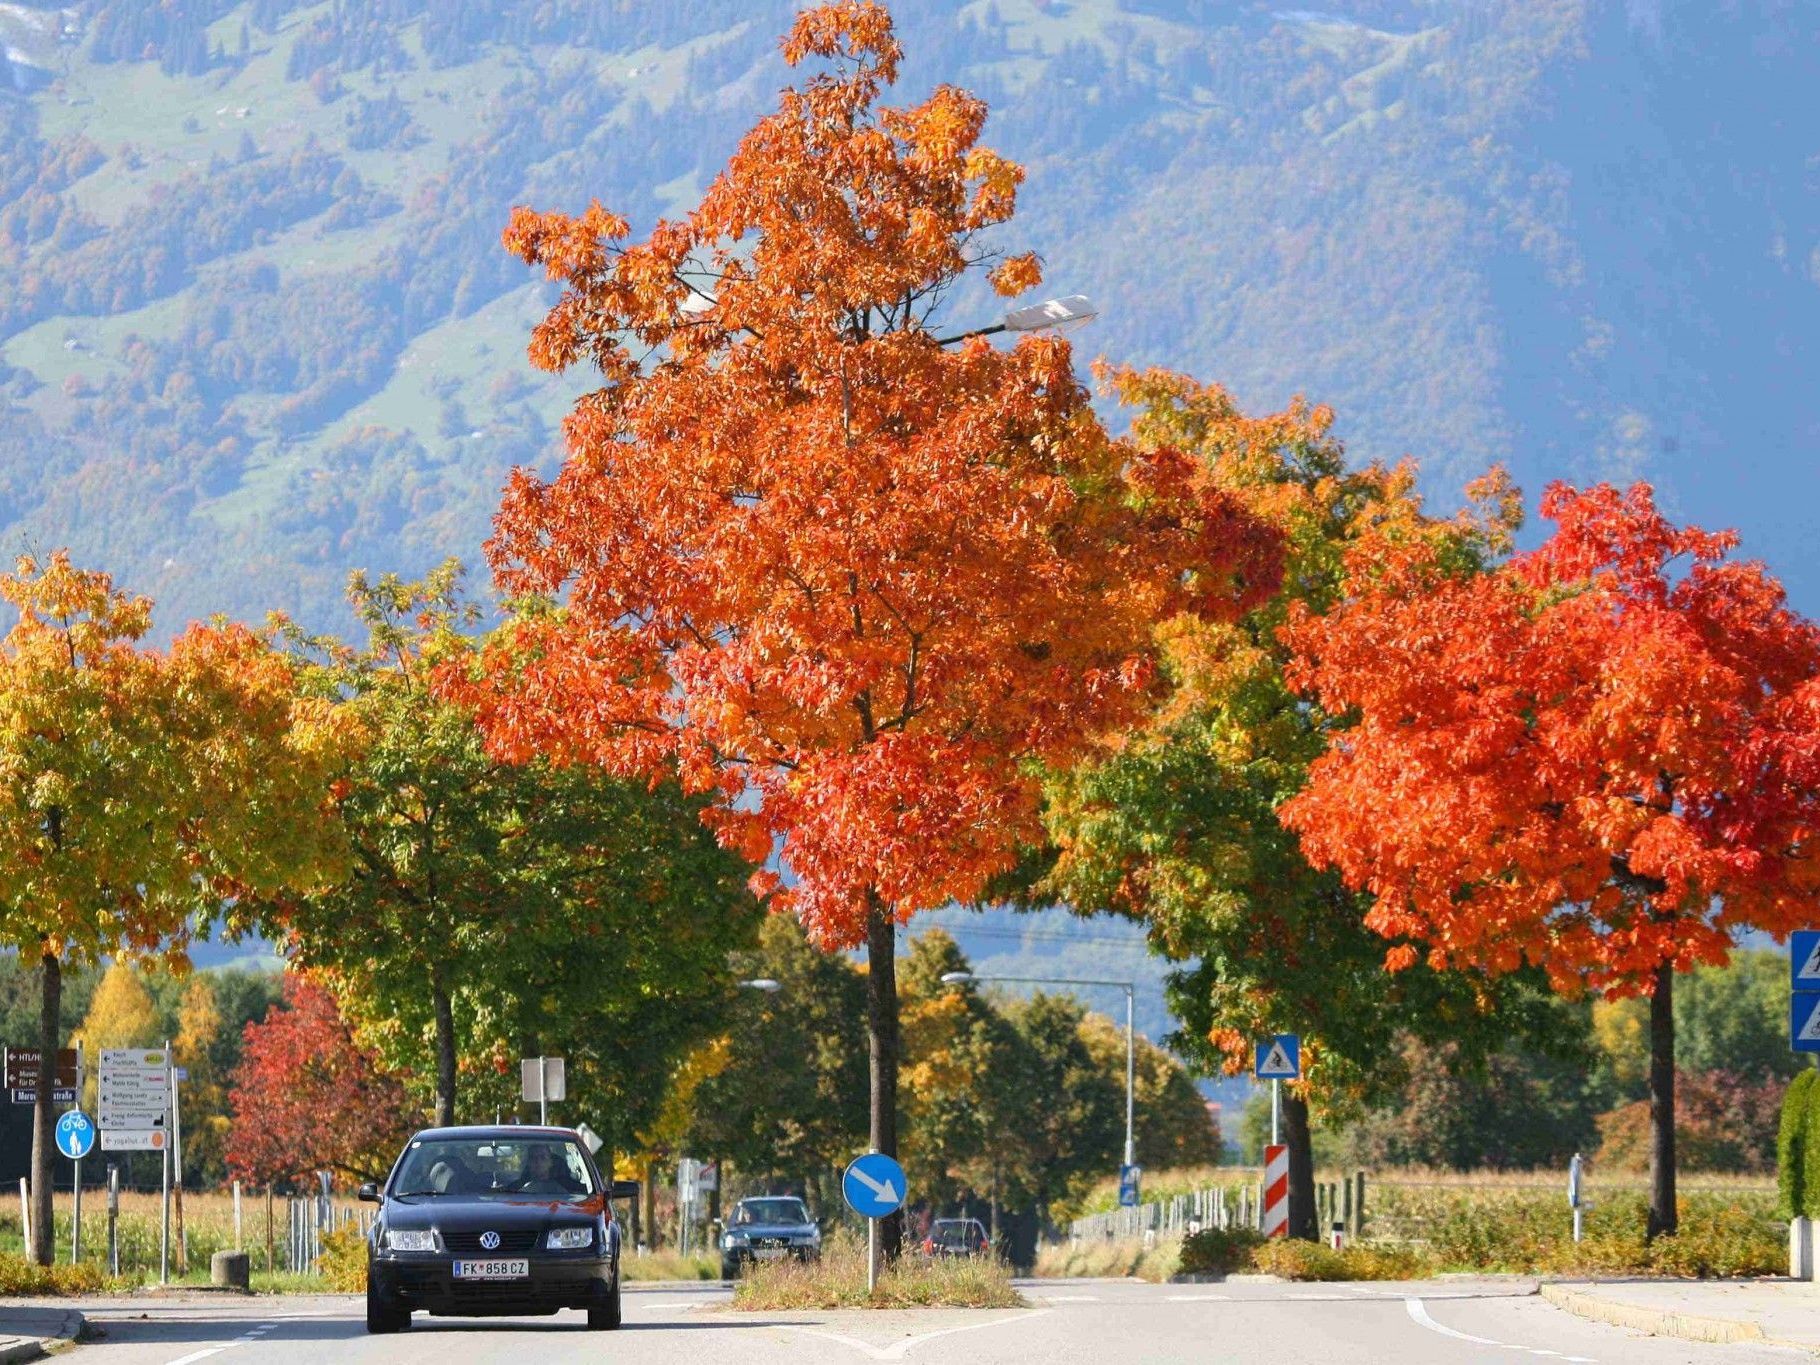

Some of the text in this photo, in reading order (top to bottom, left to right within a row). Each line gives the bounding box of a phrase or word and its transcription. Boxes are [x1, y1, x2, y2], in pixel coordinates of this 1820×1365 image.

[463, 1262, 525, 1275] FK 858 CZ
